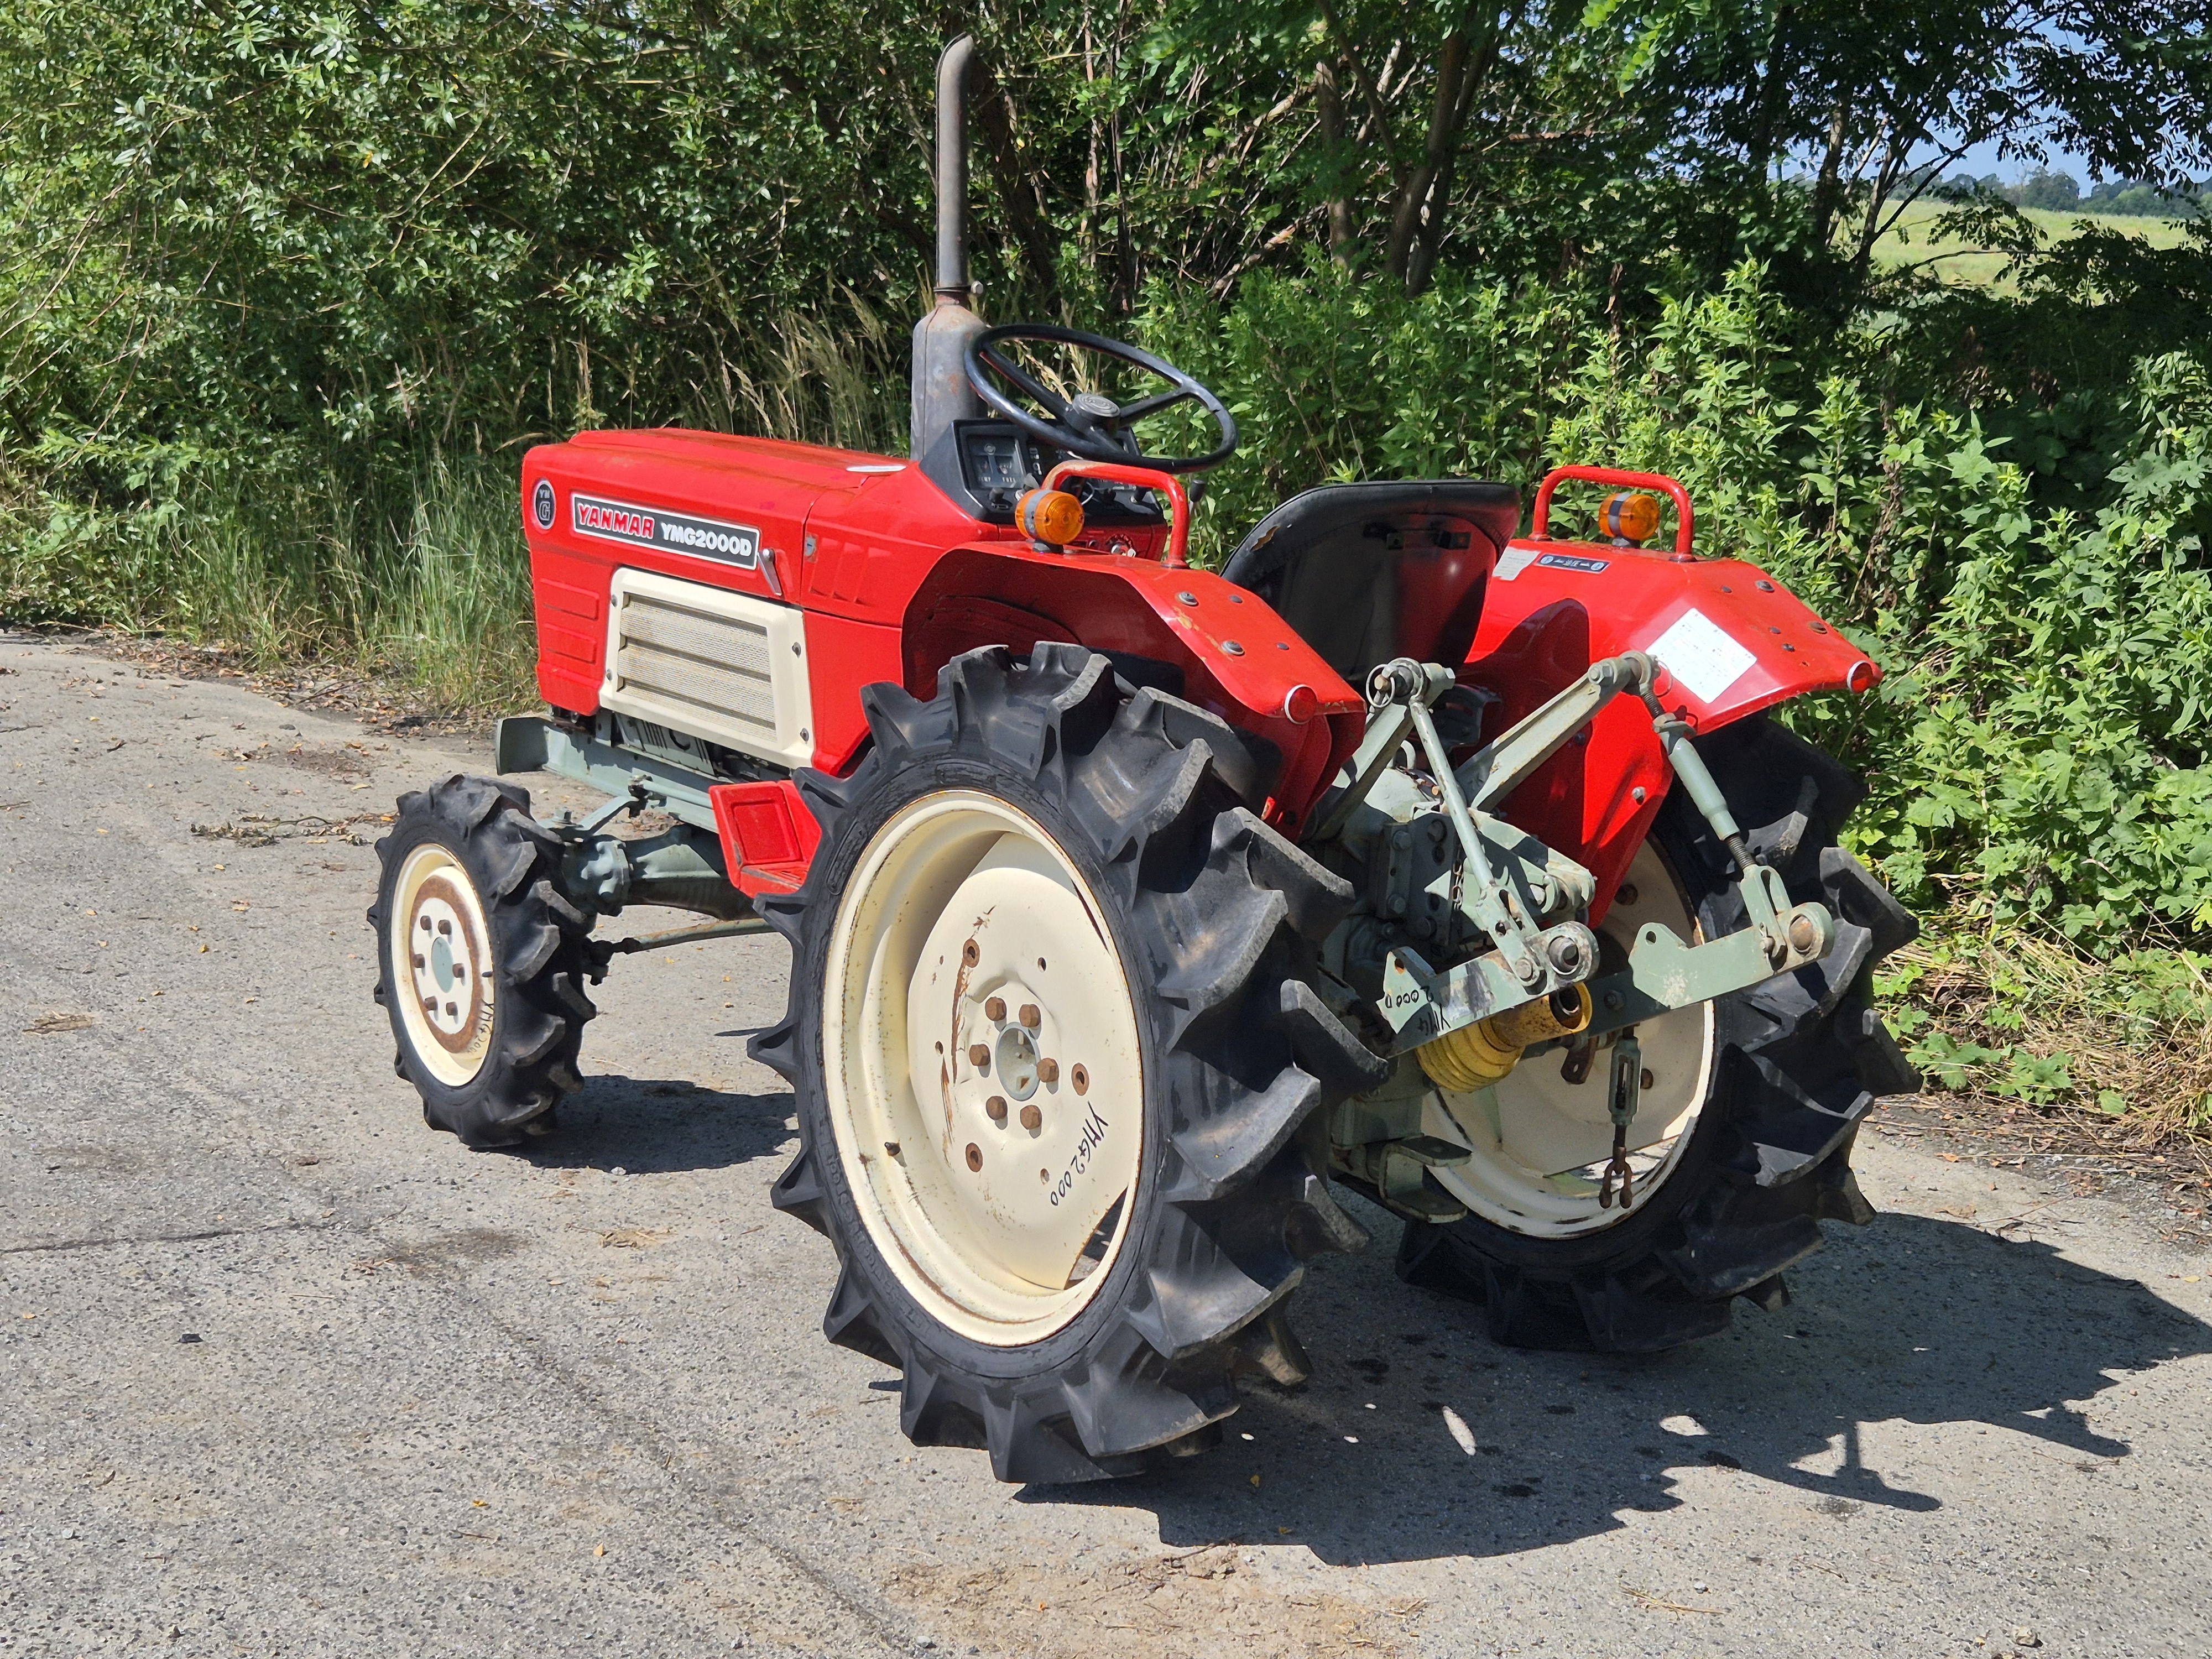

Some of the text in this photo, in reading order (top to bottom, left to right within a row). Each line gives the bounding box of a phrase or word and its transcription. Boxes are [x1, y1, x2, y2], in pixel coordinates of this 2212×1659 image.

[539, 501, 550, 521] G
[577, 503, 753, 557] YANMAR YMG2000D
[1050, 1100, 1109, 1206] YMG2000
